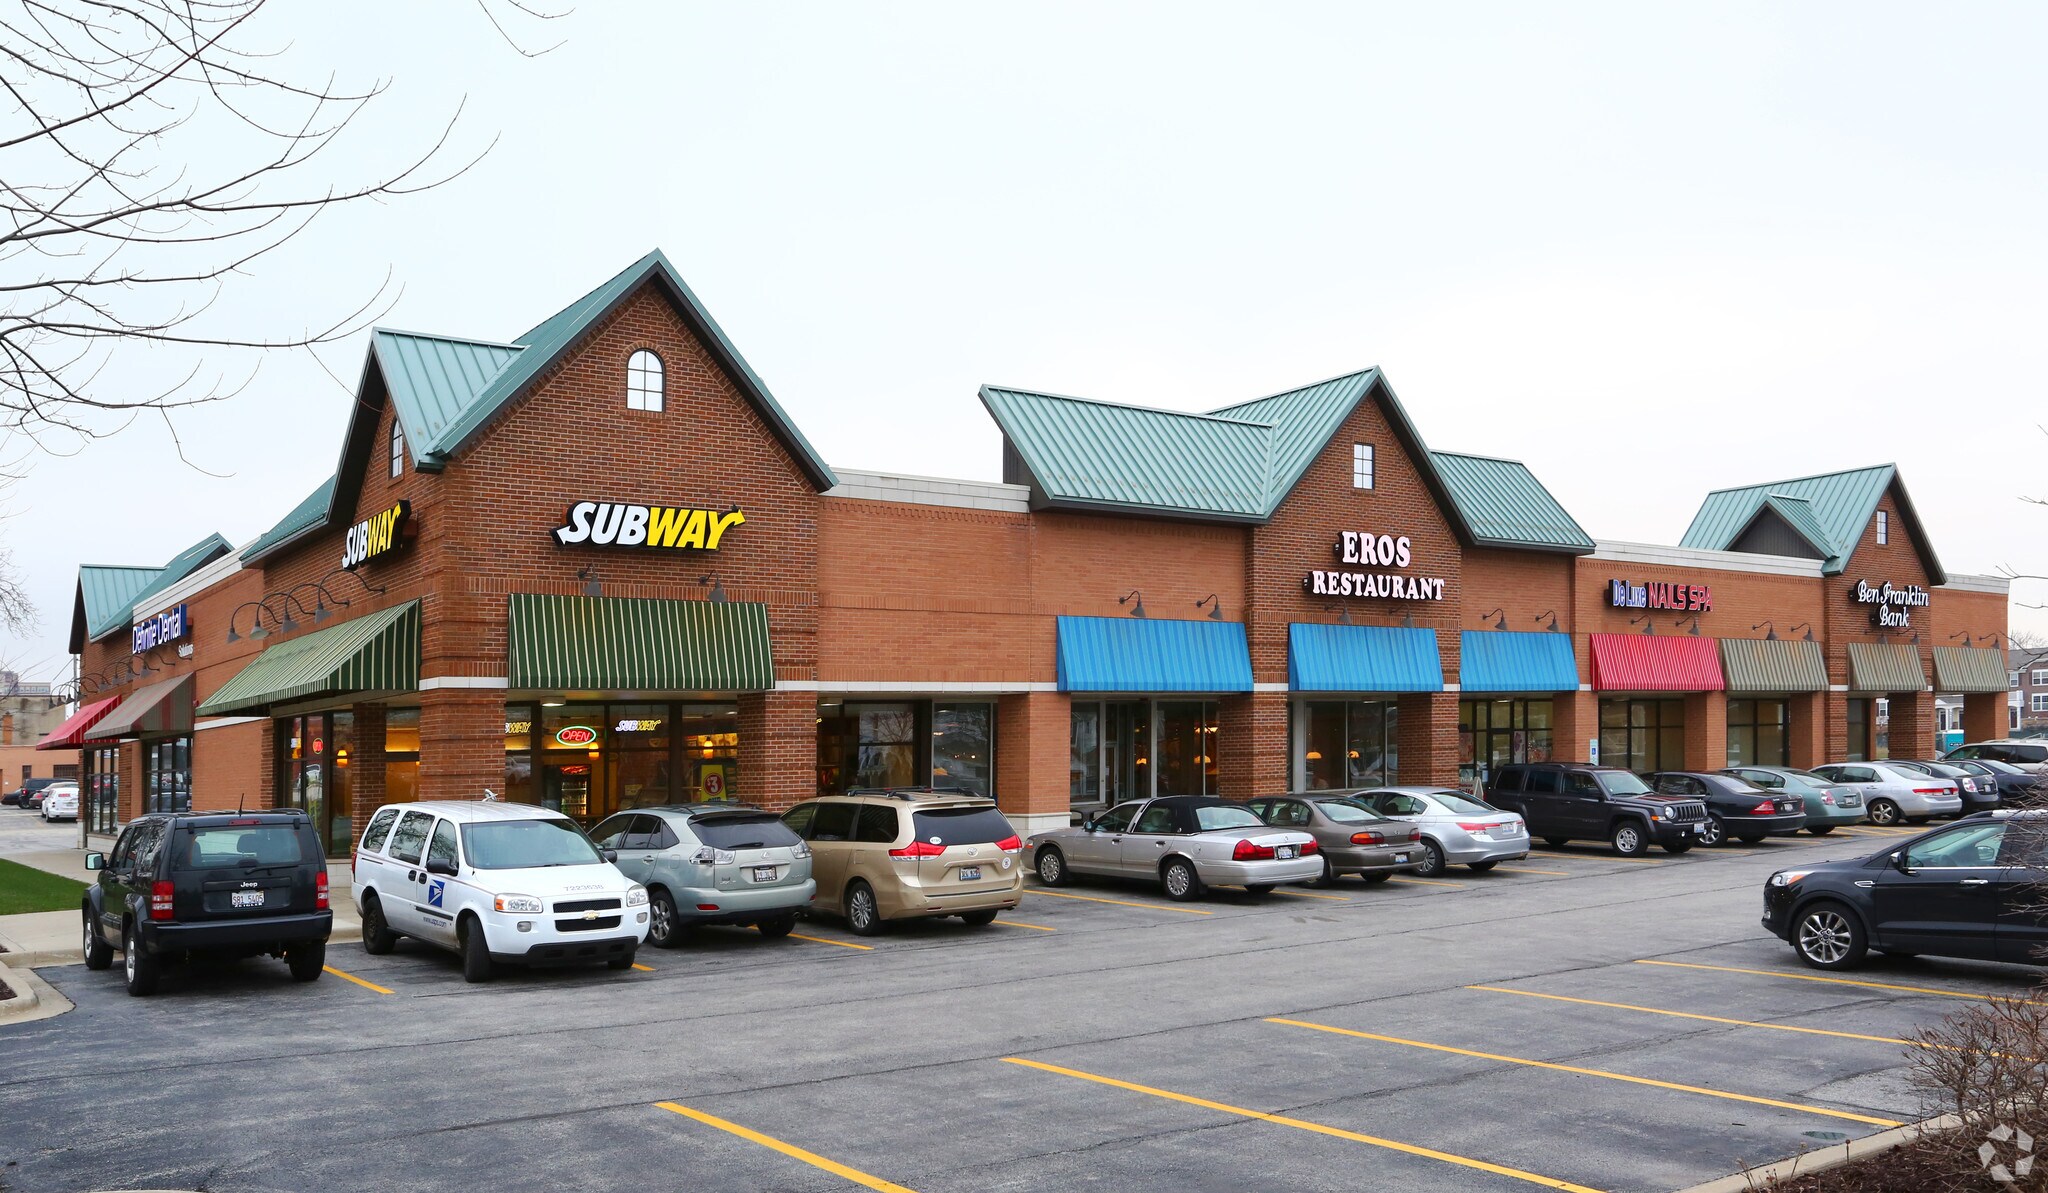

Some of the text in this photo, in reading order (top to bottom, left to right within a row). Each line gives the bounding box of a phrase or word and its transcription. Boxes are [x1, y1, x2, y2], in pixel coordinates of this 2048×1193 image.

[341, 501, 402, 569] SUBWAY
[556, 501, 746, 550] SUBWAY
[1341, 530, 1412, 568] EROS
[1312, 570, 1445, 600] RESTAURANT
[1648, 581, 1687, 610] NAILS
[1688, 584, 1713, 612] SPA
[1857, 579, 1930, 607] Ben Franklin
[158, 603, 183, 645] Dental
[1879, 603, 1910, 627] Bank
[561, 730, 590, 742] OPEN
[615, 719, 661, 732] SUBWAY
